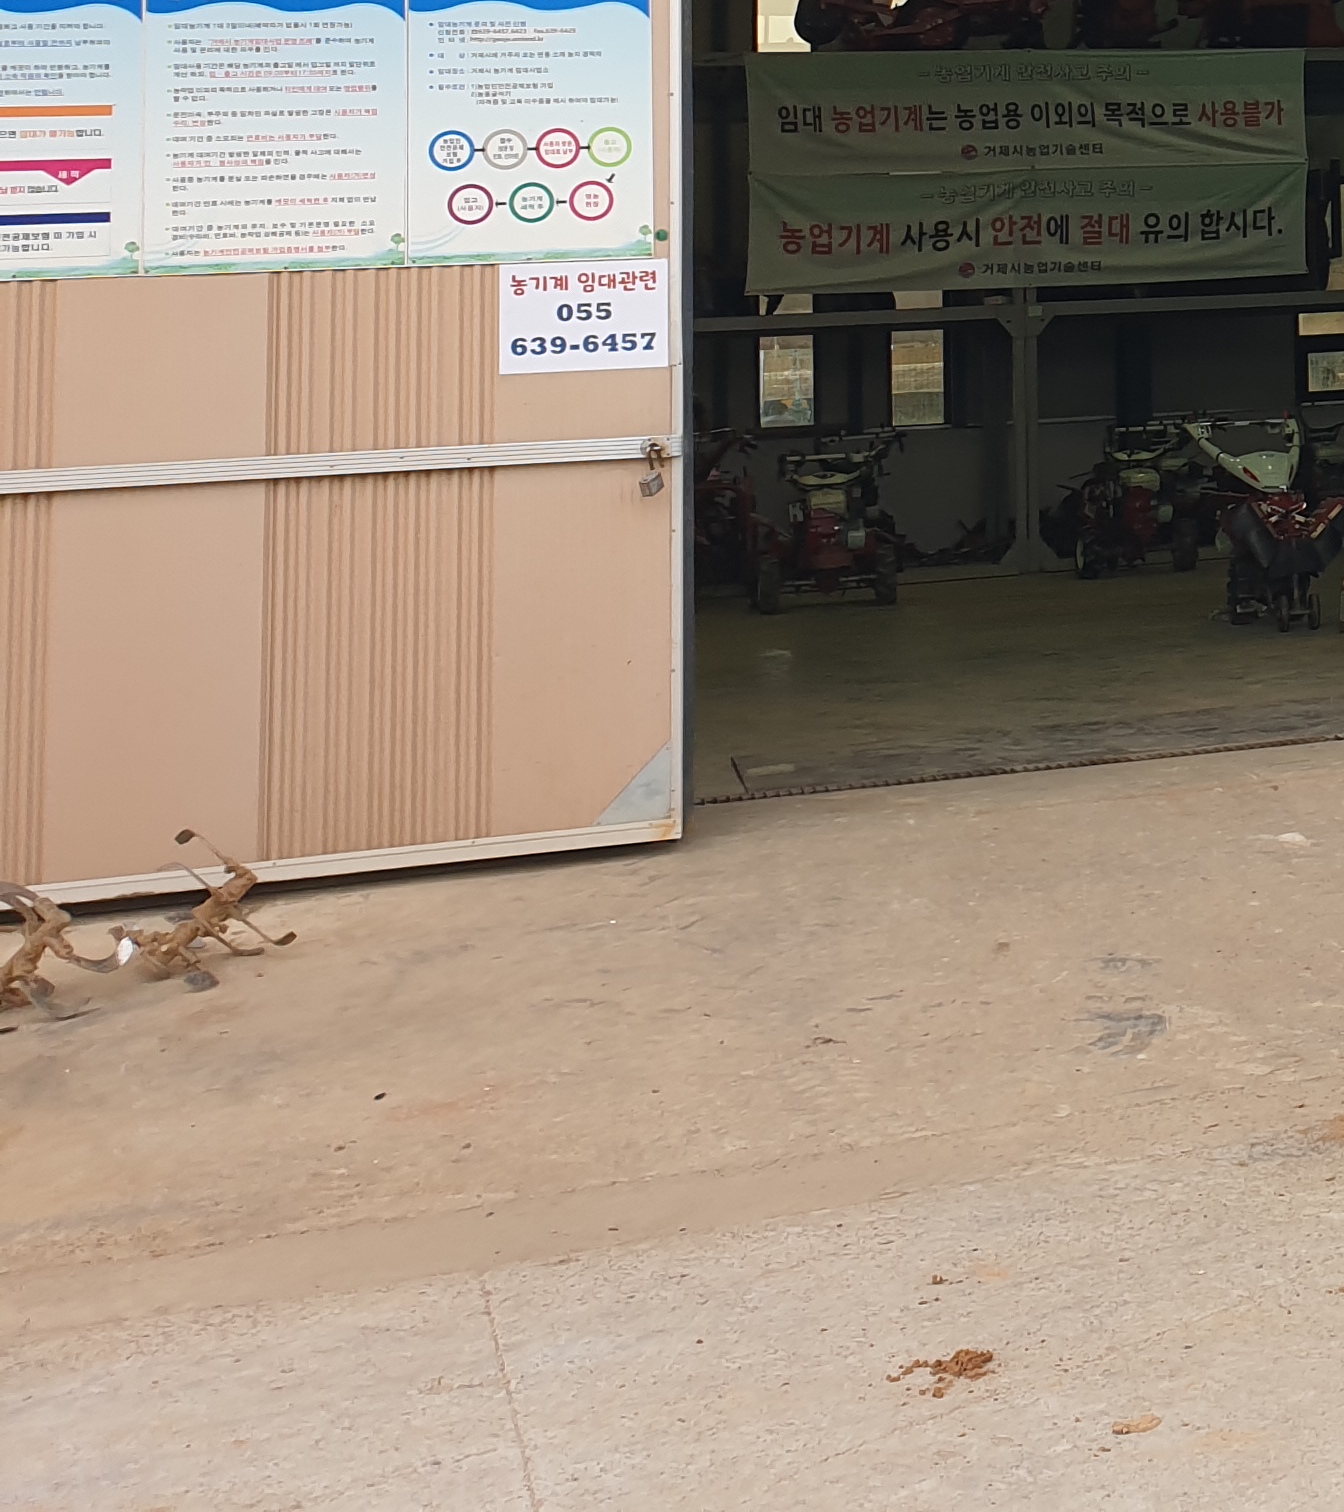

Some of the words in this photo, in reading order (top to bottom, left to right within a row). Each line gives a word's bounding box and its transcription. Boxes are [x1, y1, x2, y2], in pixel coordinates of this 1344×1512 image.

[777, 105, 823, 135] 임대
[830, 103, 947, 134] 농업기계는
[953, 102, 1023, 131] 농업용
[1030, 101, 1096, 130] 이외의
[1103, 100, 1192, 130] 목적으로
[1198, 98, 1285, 128] 사용불가
[983, 141, 1104, 158] 거제시농업기술센터
[779, 220, 892, 256] 농업기계
[900, 218, 982, 252] 사용시
[990, 213, 1071, 246] 안전에
[1079, 212, 1132, 244] 절대
[1140, 210, 1191, 244] 유의
[1199, 205, 1283, 241] 합시다.
[981, 259, 1102, 277] 거제시농업기술센터
[510, 274, 569, 296] 농기계
[577, 270, 657, 293] 임대관련
[556, 302, 612, 322] 055
[510, 332, 656, 356] 639-6457
